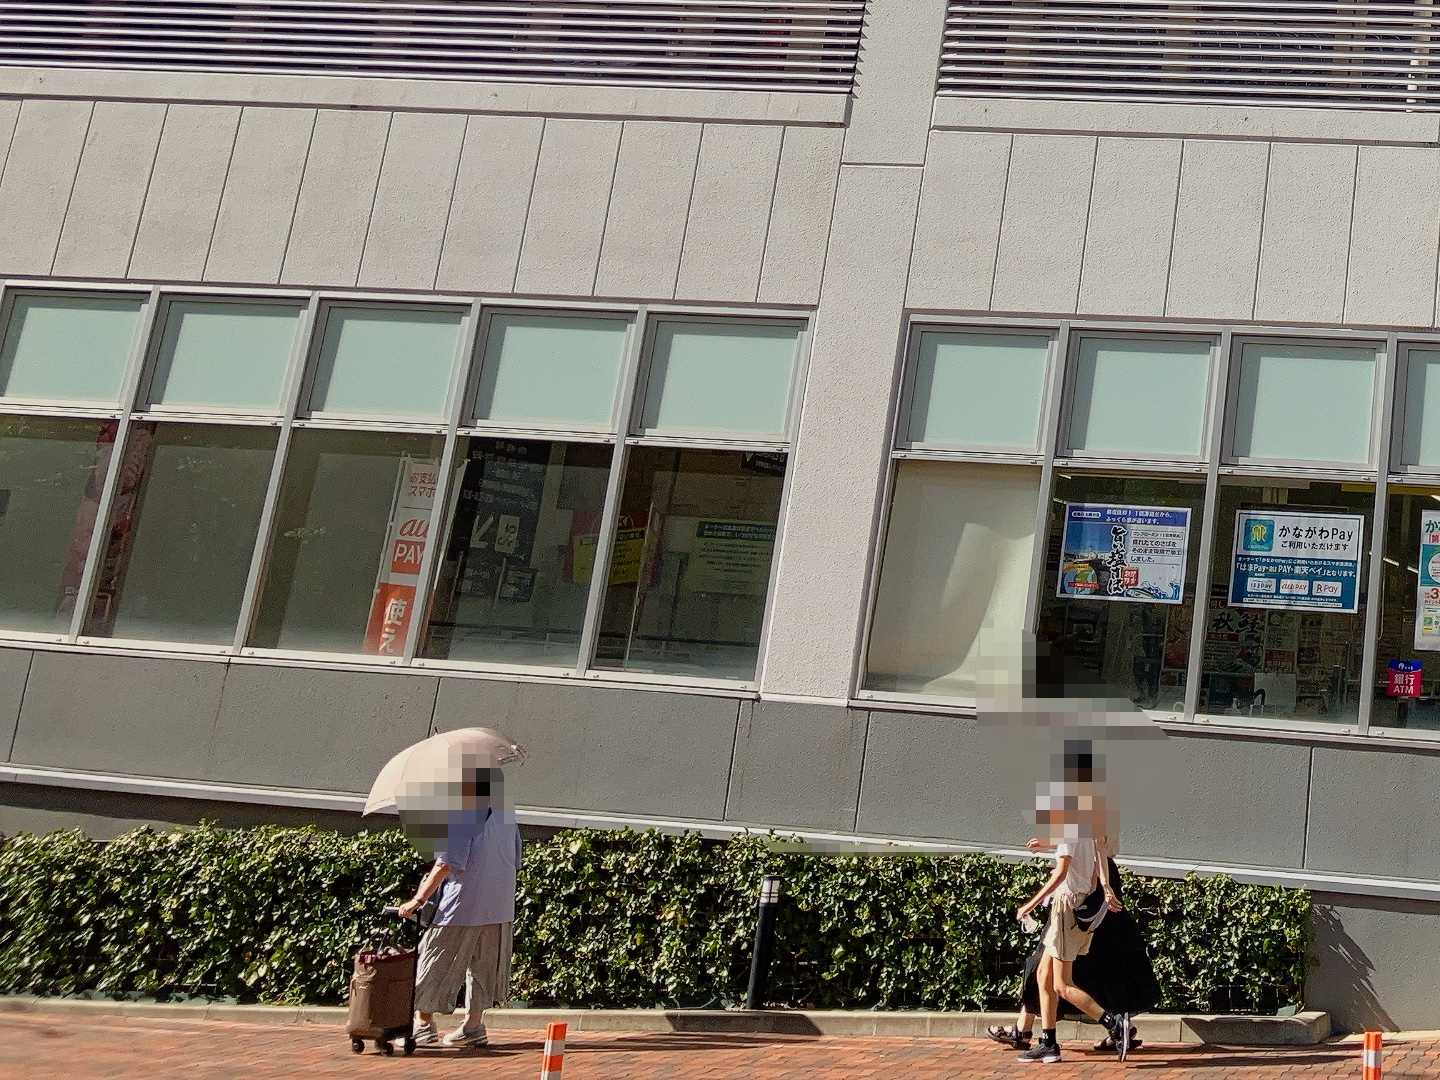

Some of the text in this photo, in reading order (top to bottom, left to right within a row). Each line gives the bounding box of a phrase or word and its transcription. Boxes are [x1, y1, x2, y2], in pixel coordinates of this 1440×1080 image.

[1278, 525, 1354, 542] かながわPay
[1280, 540, 1349, 551] ご利用いただけます
[1393, 674, 1415, 684] 銀行
[1392, 684, 1414, 695] ATM
